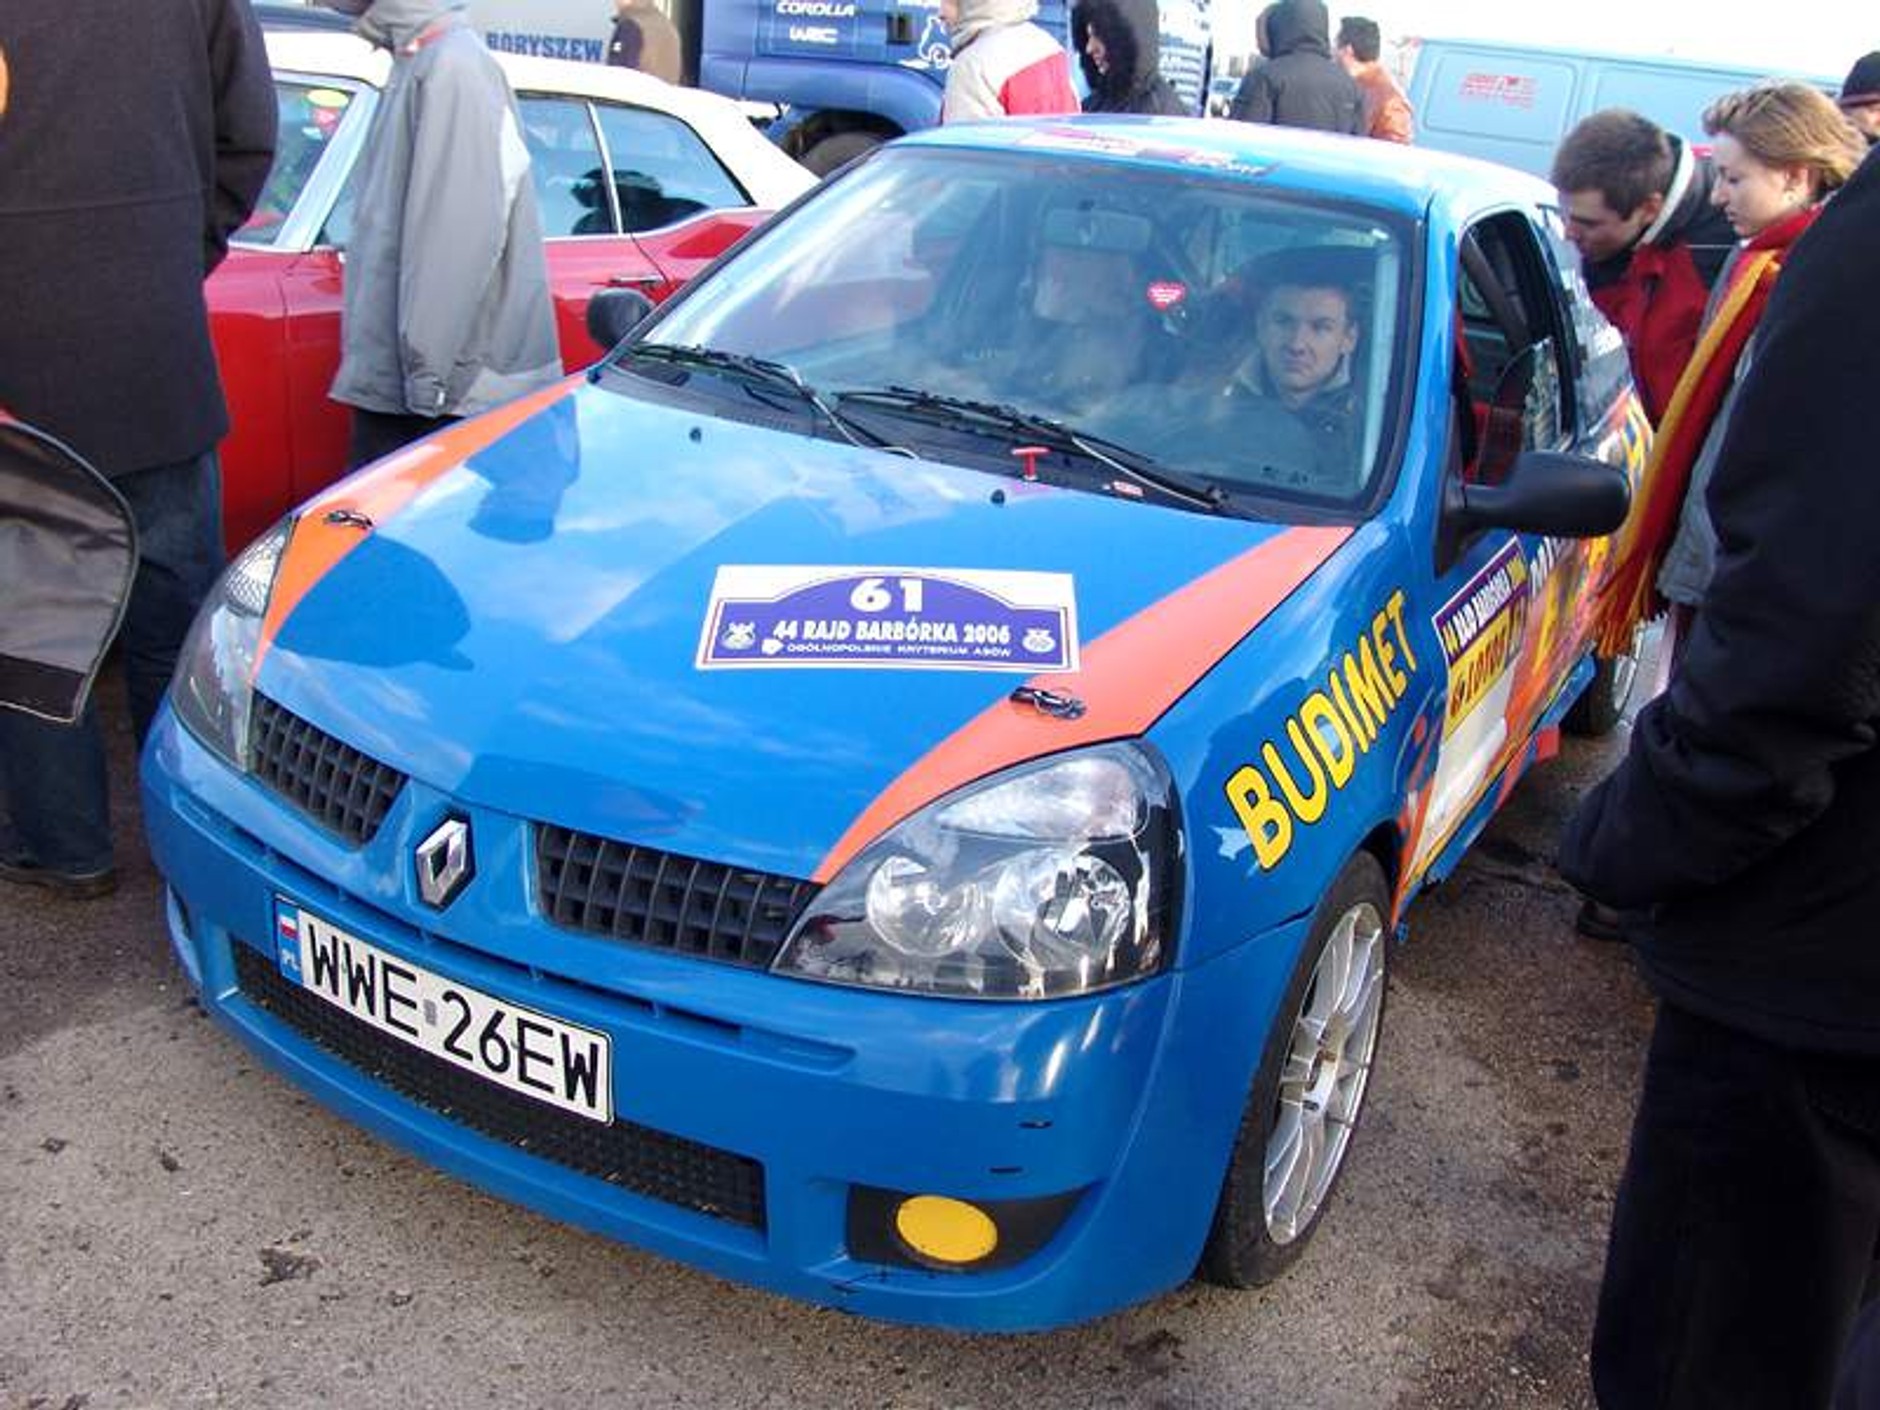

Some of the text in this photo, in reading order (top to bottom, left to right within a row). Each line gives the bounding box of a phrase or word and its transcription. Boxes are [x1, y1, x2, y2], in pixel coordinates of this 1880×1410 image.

[776, 1, 855, 17] COROLLA
[486, 32, 603, 63] BORYSZEW
[789, 26, 838, 44] WRC
[850, 578, 923, 613] 61
[773, 615, 1011, 645] 44 RAJD BARBÓRKA 2006
[1225, 589, 1416, 871] BUDIMET
[308, 923, 599, 1109] WWE 26EW
